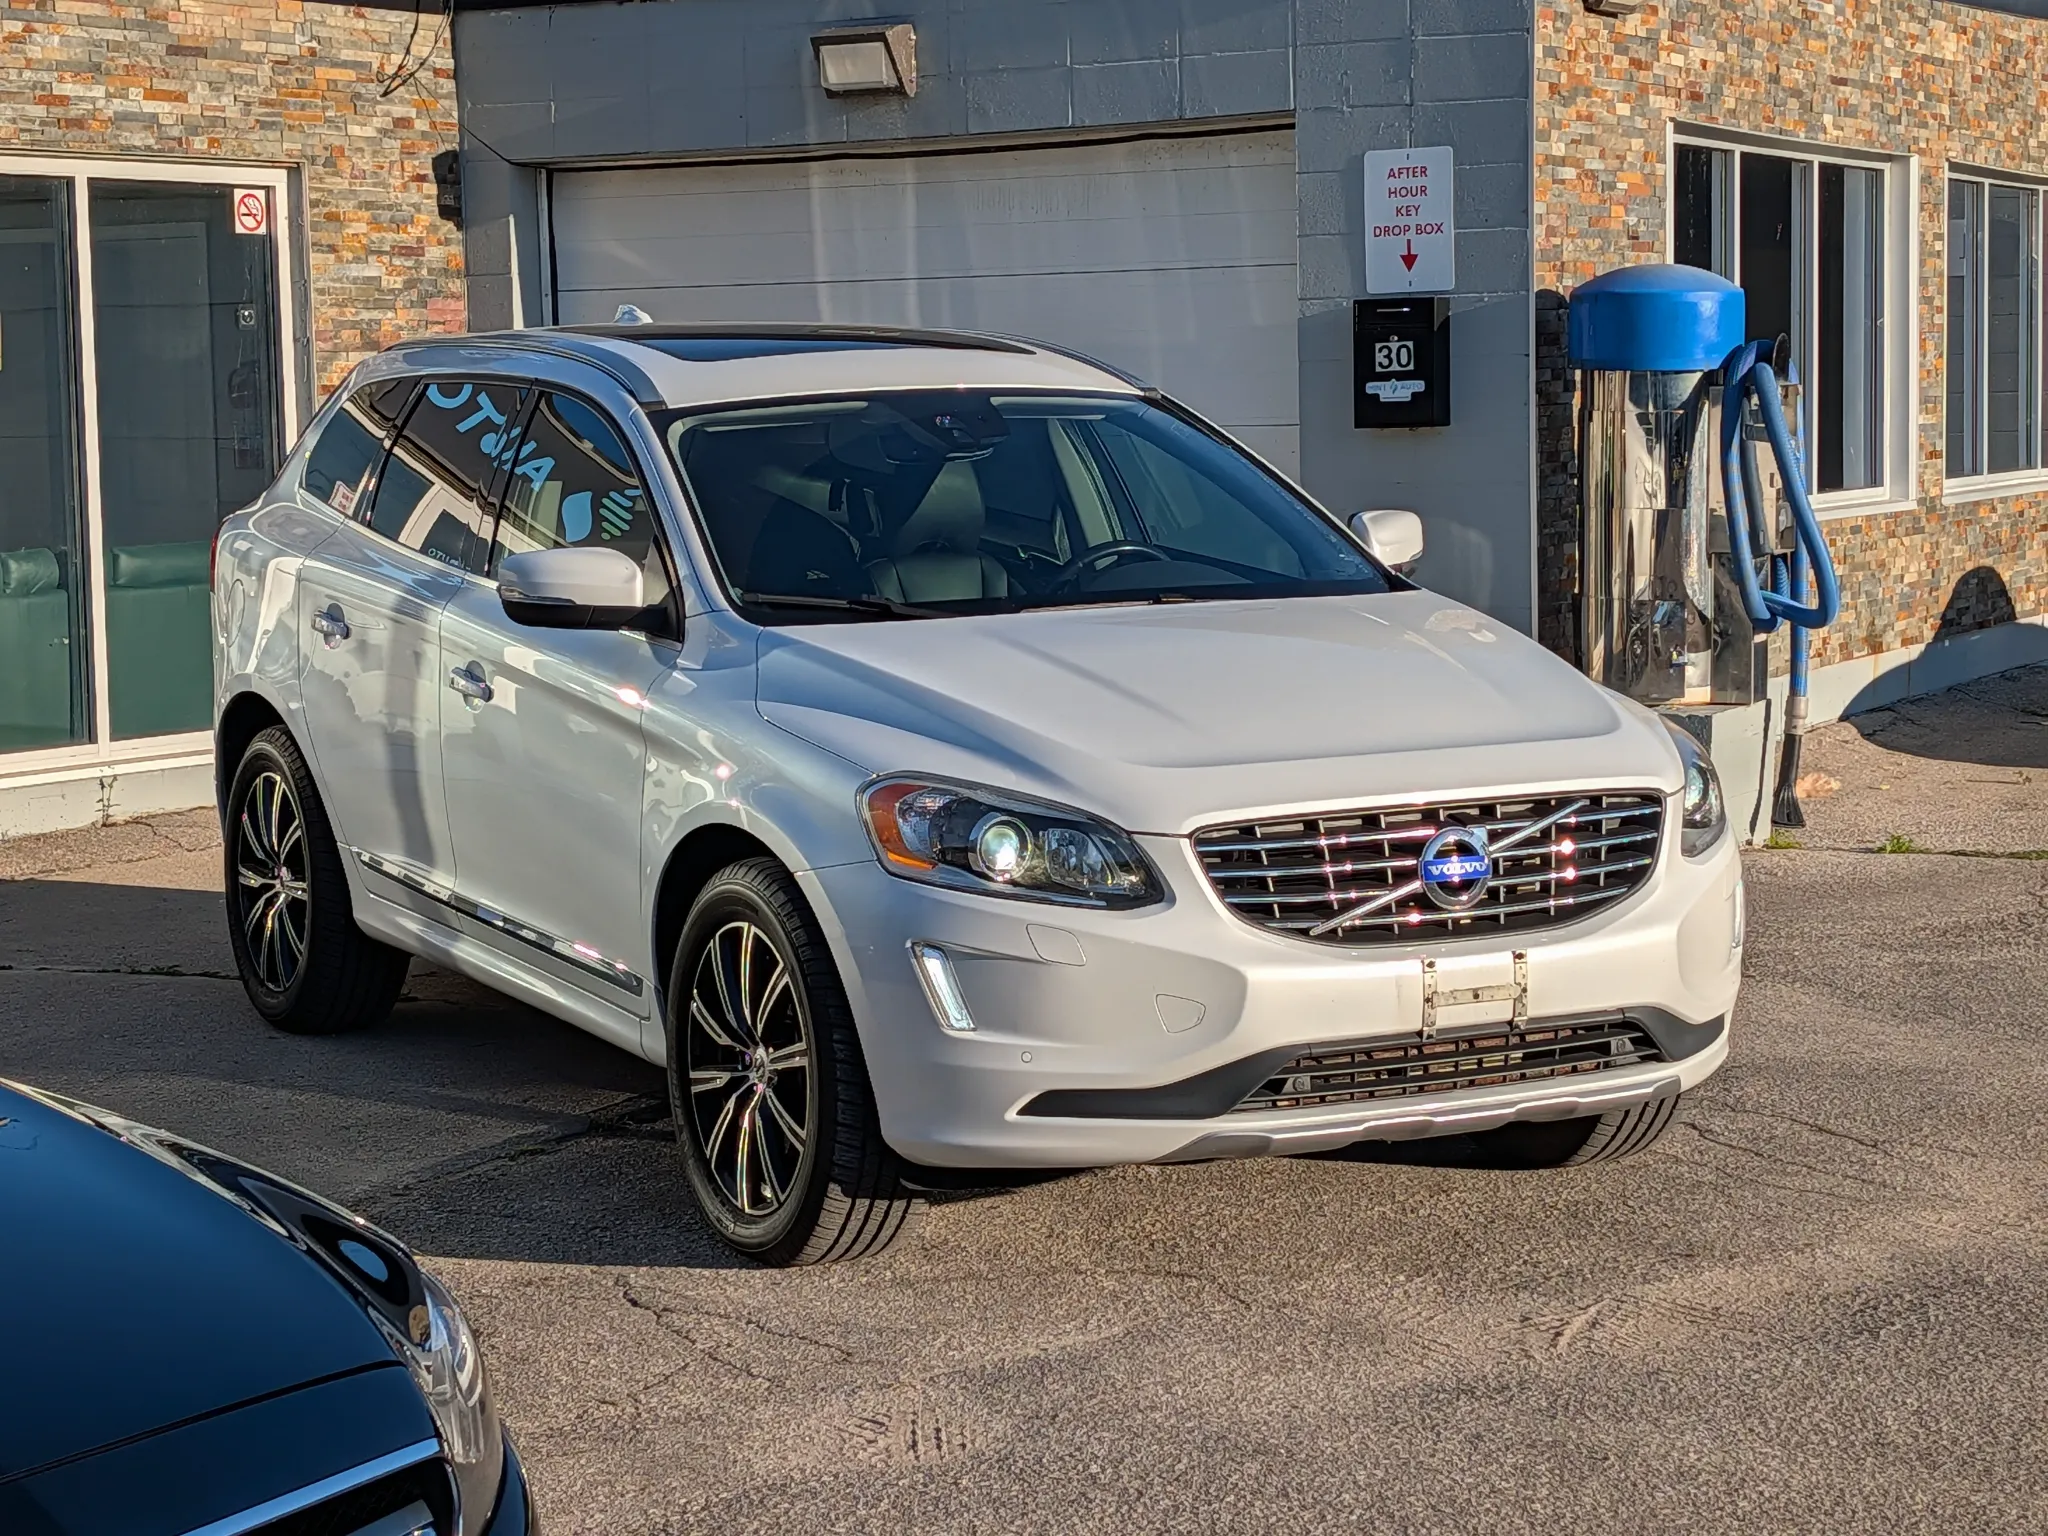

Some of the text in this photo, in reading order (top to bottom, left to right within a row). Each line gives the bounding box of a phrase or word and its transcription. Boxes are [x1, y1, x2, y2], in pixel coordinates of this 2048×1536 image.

[1387, 166, 1428, 180] AFTER
[1388, 185, 1428, 199] HOUR
[1396, 204, 1421, 217] KEY
[1373, 222, 1444, 238] DROP BOX
[1377, 344, 1412, 369] 30
[1428, 861, 1487, 876] VOLVO
